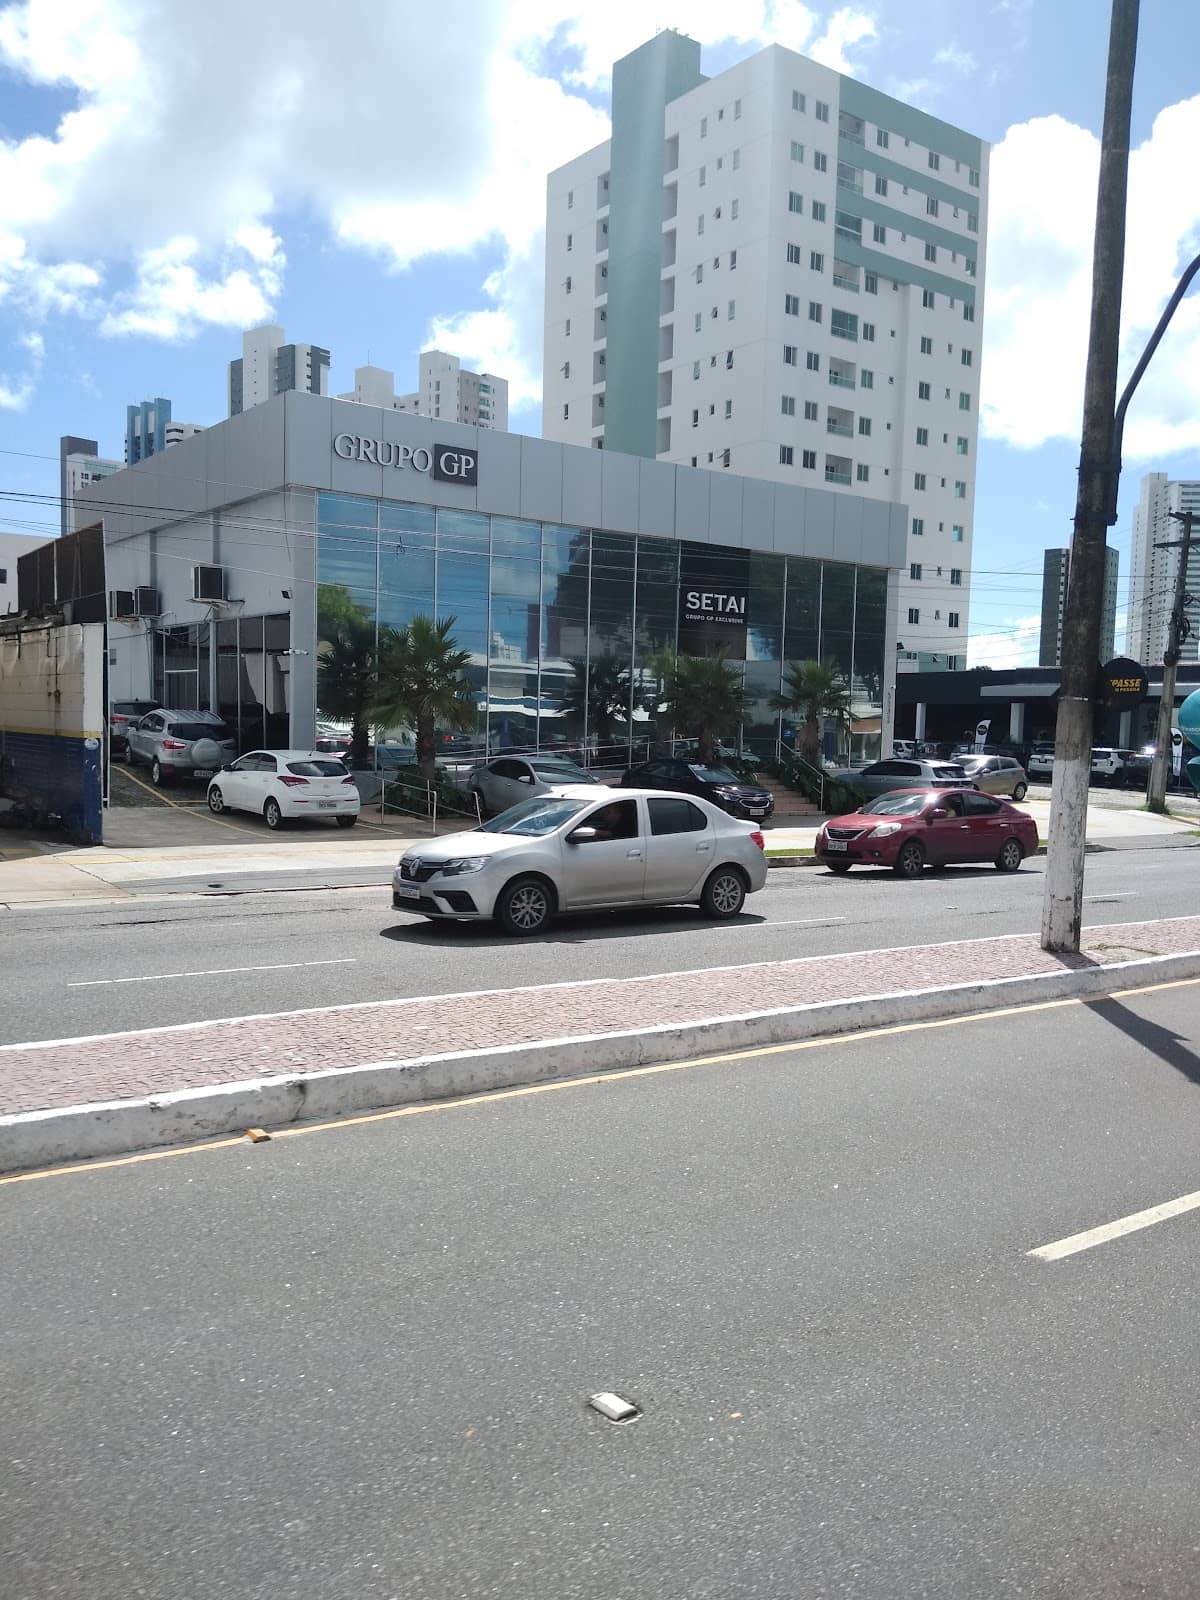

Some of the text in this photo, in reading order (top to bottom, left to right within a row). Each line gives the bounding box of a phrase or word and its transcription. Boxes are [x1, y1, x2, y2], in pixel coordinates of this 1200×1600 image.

[334, 433, 475, 477] GRUPO GP
[686, 591, 746, 614] SETAI
[1110, 678, 1142, 687] PASSE
